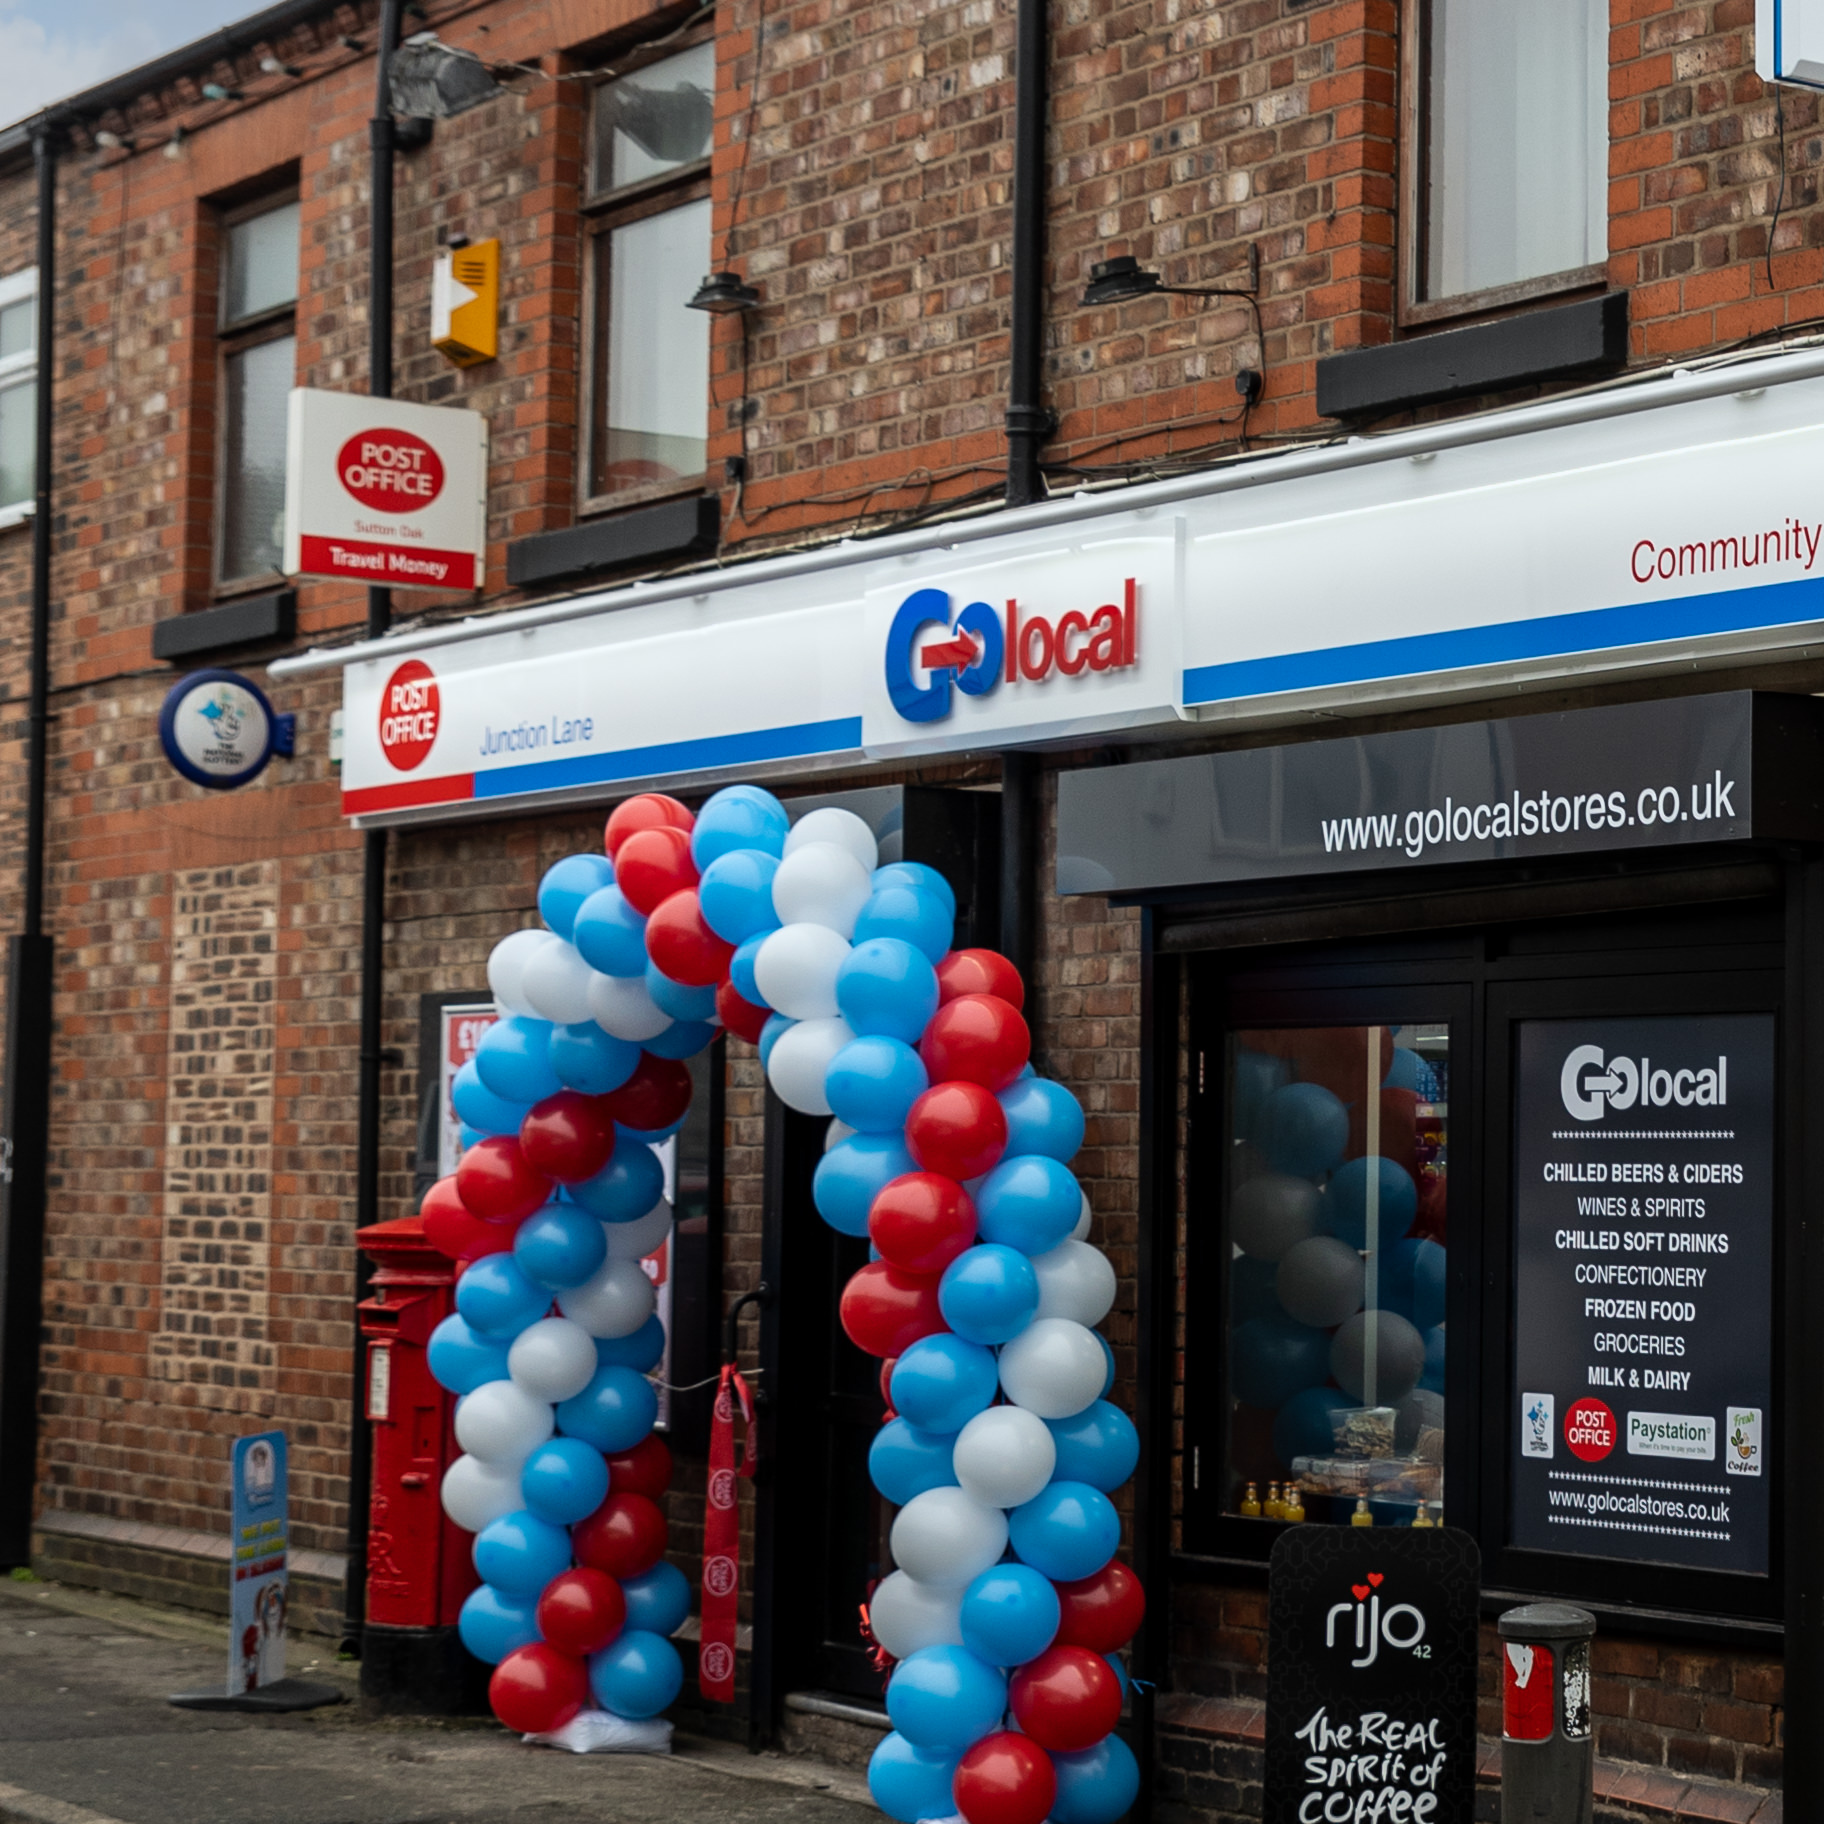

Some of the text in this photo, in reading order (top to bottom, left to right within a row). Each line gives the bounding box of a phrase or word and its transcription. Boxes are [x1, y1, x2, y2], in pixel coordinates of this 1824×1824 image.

[361, 441, 426, 470] POST
[345, 464, 434, 496] OFFICE
[329, 545, 448, 580] Travel Money
[1631, 517, 1822, 583] Community
[391, 681, 431, 713] POST
[381, 711, 436, 746] OFFICE
[480, 715, 594, 756] Junction Lane
[1322, 770, 1736, 858] www.golocalstores.co.uk
[1543, 1162, 1743, 1184] CHILLED BEERS & CIDERS
[1577, 1196, 1706, 1218] WINES & SPIRITS
[1555, 1230, 1729, 1253] CHILLED SOFT DRINKS
[1575, 1263, 1707, 1287] CONFECTIONERY
[1585, 1298, 1696, 1321] FROZEN FOOD
[1593, 1332, 1685, 1356] GROCERIES
[1588, 1366, 1691, 1391] MILK & DAIRY
[1576, 1409, 1607, 1428] POST
[1631, 1418, 1706, 1442] Paystation
[1733, 1411, 1755, 1427] Fresh
[1568, 1427, 1611, 1447] OFFICE
[1727, 1460, 1759, 1472] Coffee
[1549, 1490, 1730, 1522] www.golocalstores.co.uk
[1326, 1595, 1426, 1668] rijo
[1412, 1644, 1432, 1659] 42
[1294, 1705, 1352, 1753] The
[1409, 1751, 1446, 1791] of
